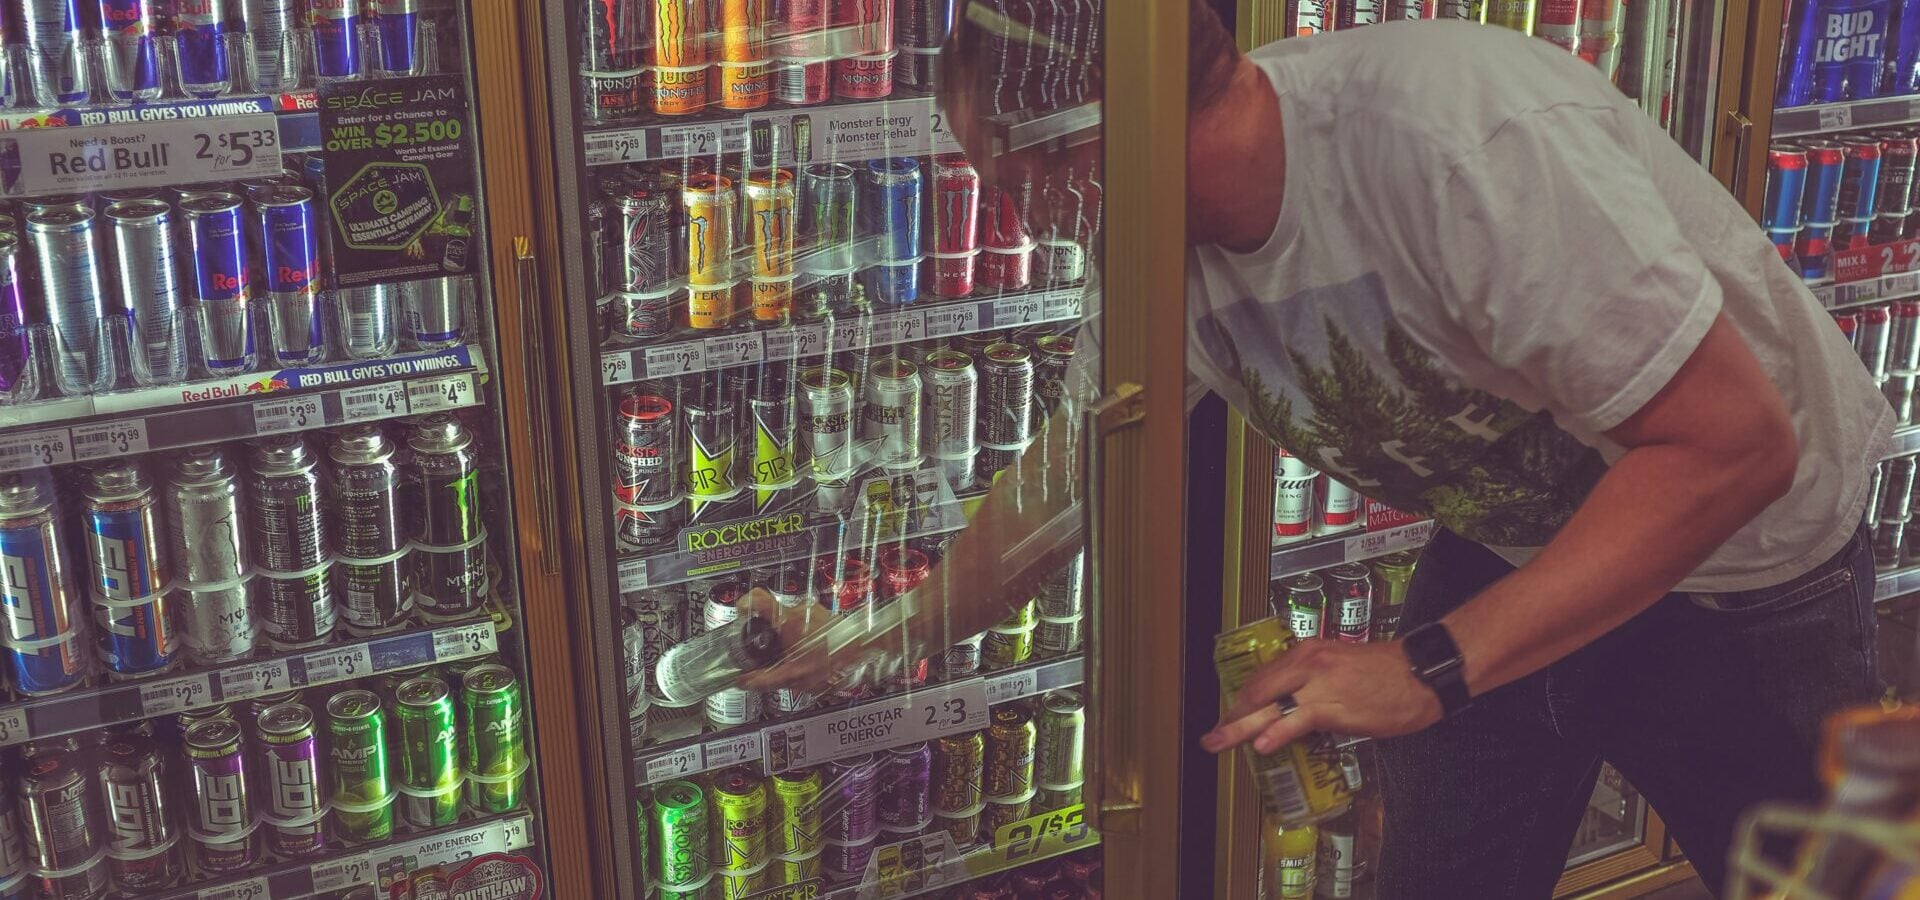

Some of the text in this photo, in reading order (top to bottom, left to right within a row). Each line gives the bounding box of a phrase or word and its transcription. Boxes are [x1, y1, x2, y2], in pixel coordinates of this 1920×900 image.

[1826, 10, 1873, 38] BUD
[1815, 33, 1880, 62] LIGHT
[327, 87, 455, 112] SPACE JAM
[82, 113, 105, 127] RED
[110, 110, 139, 124] BULL
[142, 107, 178, 121] GIVES
[180, 104, 207, 118] YOU
[337, 116, 366, 126] Enter
[368, 114, 384, 124] for
[393, 111, 433, 122] Chance
[436, 109, 448, 118] to
[829, 114, 914, 132] Monster Energy
[930, 113, 943, 134] 2
[70, 138, 96, 149] Need
[110, 135, 146, 147] Boost?
[326, 119, 462, 152] OVER $2,500
[331, 126, 366, 140] WIN
[825, 128, 917, 145] & Monster Rehab
[194, 133, 214, 160] 2
[395, 143, 459, 157] Worth of Essential
[402, 150, 454, 163] Camping Gear
[50, 143, 168, 175] Red Bull
[340, 171, 421, 210] SPACE JAM
[349, 196, 429, 233] ULTIMATE CAMPING
[351, 225, 398, 243] ESSENTIALS
[396, 202, 432, 231] GIVEAWAY
[1837, 255, 1859, 269] MIX
[299, 373, 323, 390] RED
[323, 369, 351, 386] BULL
[352, 366, 385, 382] GIVES
[386, 362, 411, 378] YOU
[182, 383, 240, 403] Red Bull
[698, 542, 755, 565] ENERGY
[827, 706, 901, 735] ROCKSTAR
[924, 705, 939, 726] 2
[943, 696, 967, 726] $3
[839, 722, 894, 746] ENERGY
[418, 842, 443, 855] AMP
[445, 832, 486, 849] ENERGY
